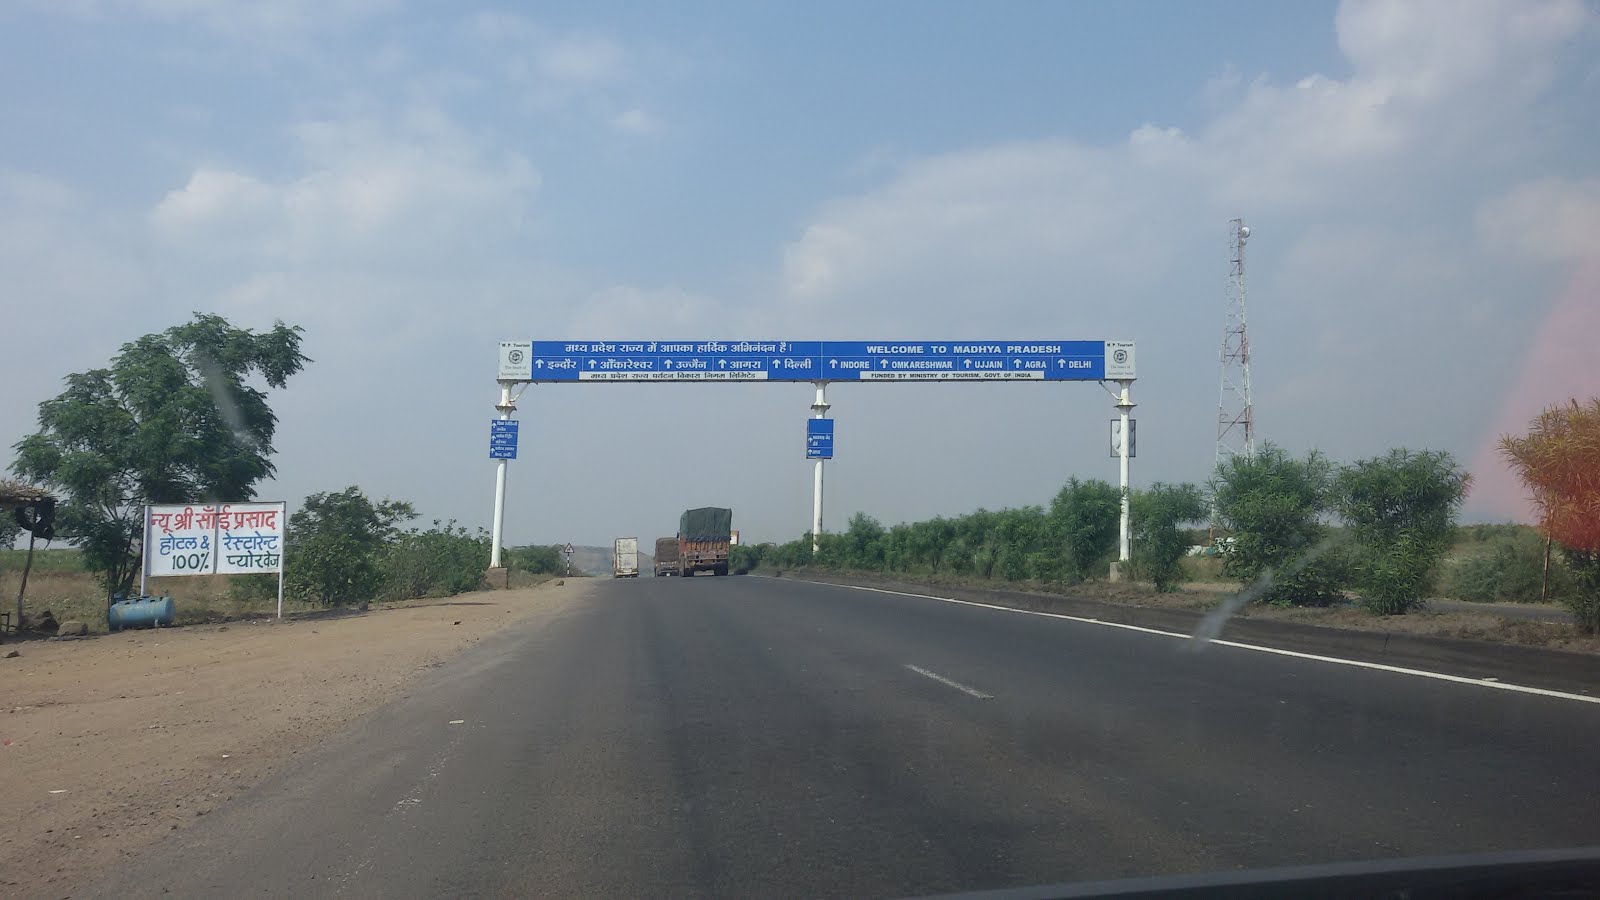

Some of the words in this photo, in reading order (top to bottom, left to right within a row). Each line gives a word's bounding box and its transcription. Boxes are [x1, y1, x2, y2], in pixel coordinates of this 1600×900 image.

[565, 343, 588, 353] मध्य
[591, 342, 616, 353] प्रदेश
[619, 343, 643, 353] राज्य
[646, 342, 658, 353] में
[660, 343, 693, 353] आपका
[697, 342, 728, 353] हार्दिक
[731, 342, 776, 353] अभिनंदन
[866, 345, 924, 354] WELCOME
[931, 345, 947, 354] TO
[953, 345, 1001, 354] MADHYA
[1007, 345, 1061, 353] PRADESH
[676, 358, 707, 369] उज्जैन
[730, 360, 761, 369] आगरा
[784, 357, 812, 370] दिल्ली
[840, 361, 870, 369] INDORE
[891, 361, 953, 369] OMKARESHWAR
[974, 360, 1003, 369] UJJAIN
[1024, 360, 1047, 369] AGRA
[1068, 360, 1092, 369] DELHI
[151, 513, 174, 534] न्यू
[174, 506, 194, 531] श्री
[233, 511, 278, 530] प्रसाद
[160, 533, 197, 556] होटल
[200, 535, 210, 551] &
[172, 551, 210, 573] 100%
